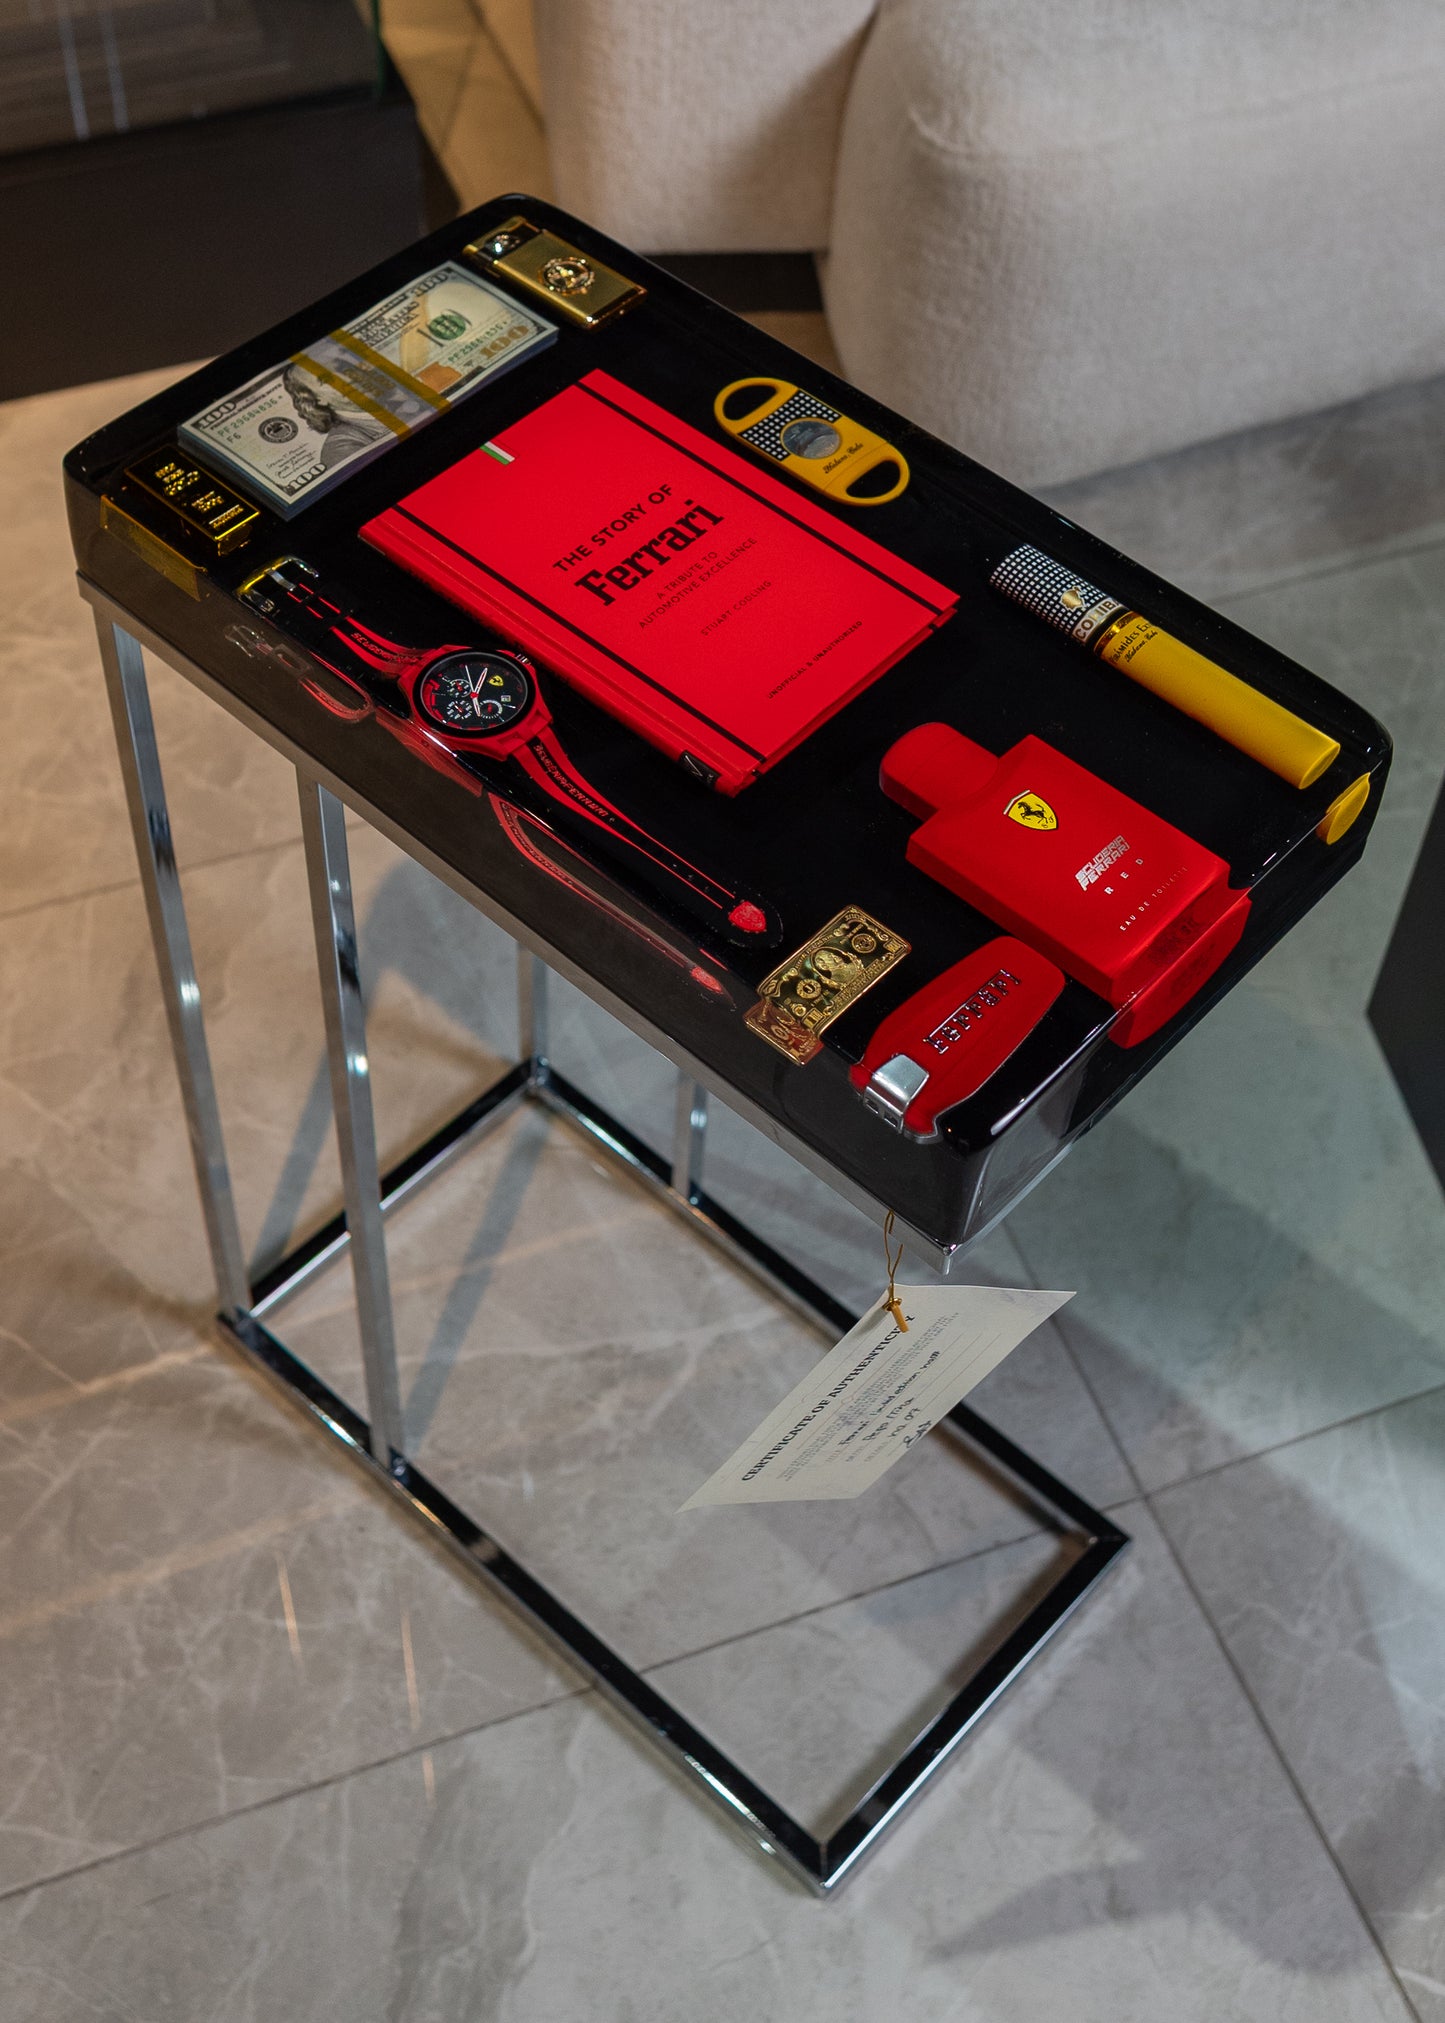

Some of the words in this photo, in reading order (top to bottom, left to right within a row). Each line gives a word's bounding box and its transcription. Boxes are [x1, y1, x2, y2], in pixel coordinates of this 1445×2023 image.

[481, 325, 530, 360] 100
[198, 401, 237, 429] 100
[288, 462, 328, 493] 100
[553, 544, 593, 572] THE
[591, 504, 647, 547] STORY
[648, 484, 673, 504] OF
[574, 498, 725, 607] Ferrari
[638, 580, 703, 629] AUTOMOTIVE
[699, 537, 758, 583] EXCELLENCE
[656, 591, 665, 600] A
[664, 561, 705, 594] TRIBUTE
[702, 551, 718, 564] TO
[700, 609, 733, 637] STUART
[768, 666, 807, 700] UNOFFICIAL
[812, 620, 864, 662] UNAUTHORIZED
[1075, 834, 1126, 880] SCUDERIA
[1079, 841, 1131, 892] FERRARI
[1119, 914, 1137, 931] EAU
[1138, 901, 1150, 912] DE
[741, 1414, 817, 1482] CERTIFICATE
[811, 1399, 831, 1414] OF
[827, 1315, 916, 1398] AUTHENTICIY
